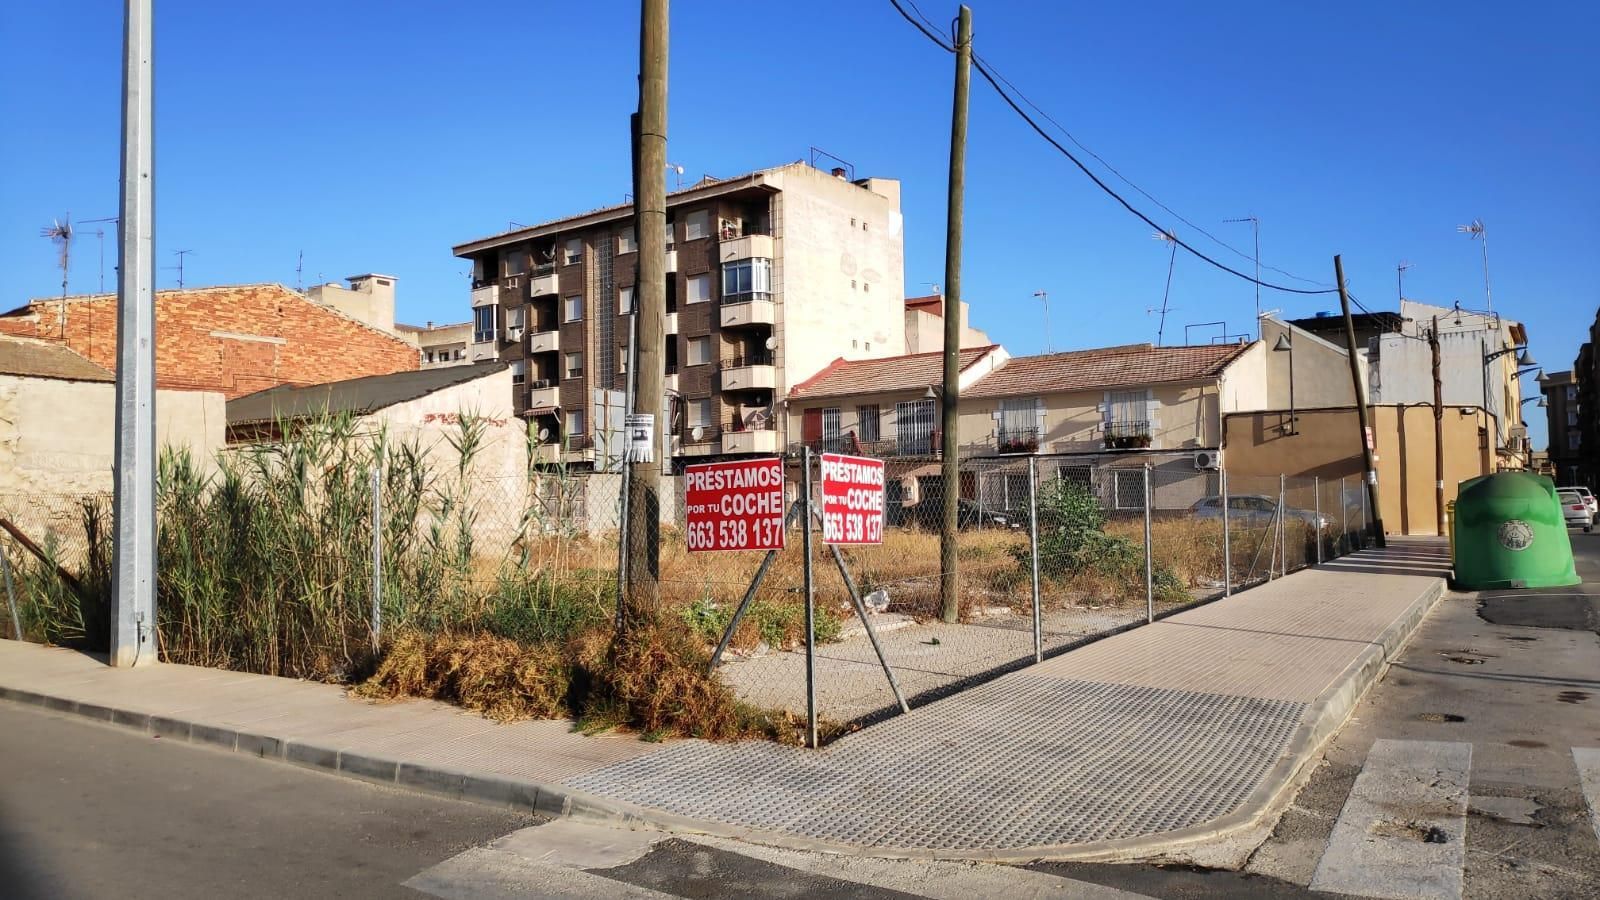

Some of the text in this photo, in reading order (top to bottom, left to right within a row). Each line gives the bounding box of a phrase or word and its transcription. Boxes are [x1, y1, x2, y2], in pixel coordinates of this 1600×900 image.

[686, 466, 781, 492] PRÉSTAMOS
[823, 457, 883, 485] PRÉSTAMOS
[687, 491, 782, 517] POR TU COCHE
[824, 488, 882, 511] POR TU COCHE
[688, 517, 782, 549] 663 538 137
[824, 512, 882, 542] 663 538 137
